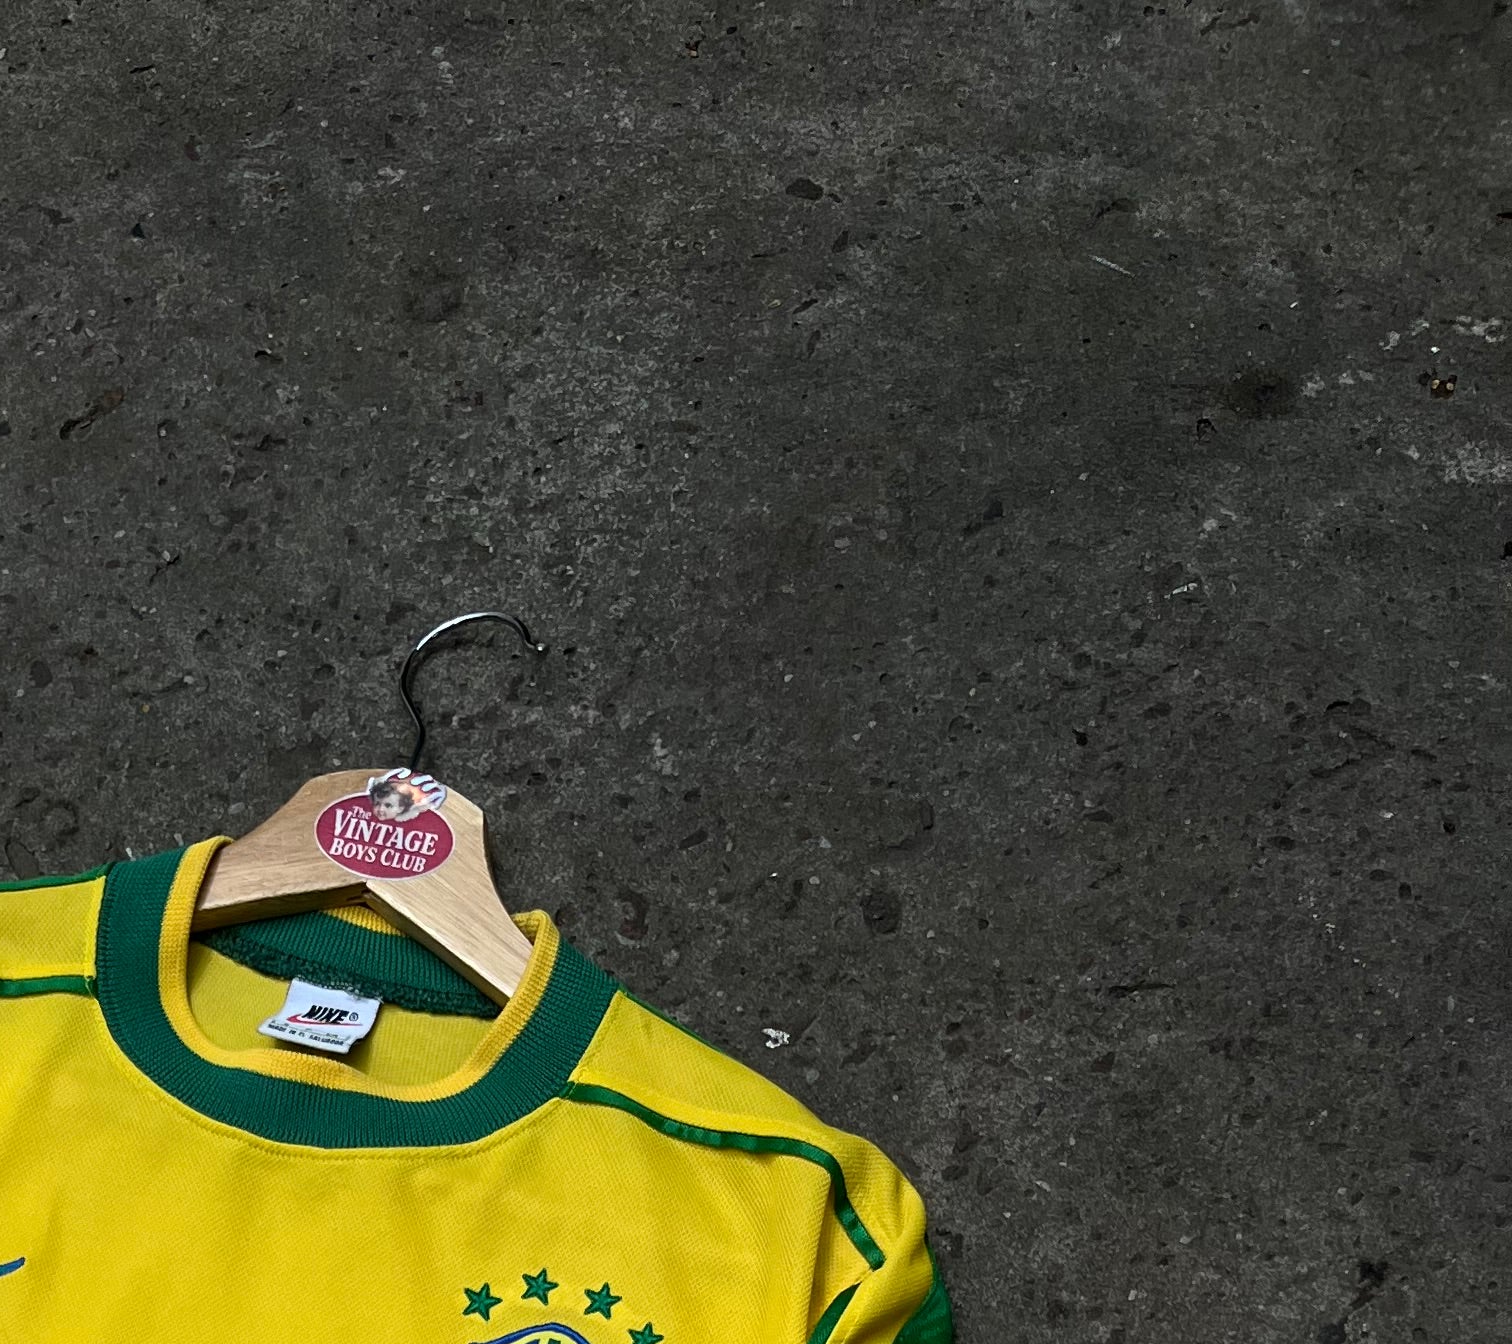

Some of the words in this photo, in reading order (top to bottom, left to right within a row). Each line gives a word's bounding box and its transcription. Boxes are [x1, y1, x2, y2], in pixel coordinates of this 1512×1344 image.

[352, 805, 372, 820] The
[333, 808, 439, 856] VINTAGE
[329, 838, 378, 863] BOYS
[380, 849, 427, 873] CLUB
[302, 1005, 349, 1024] NIKE
